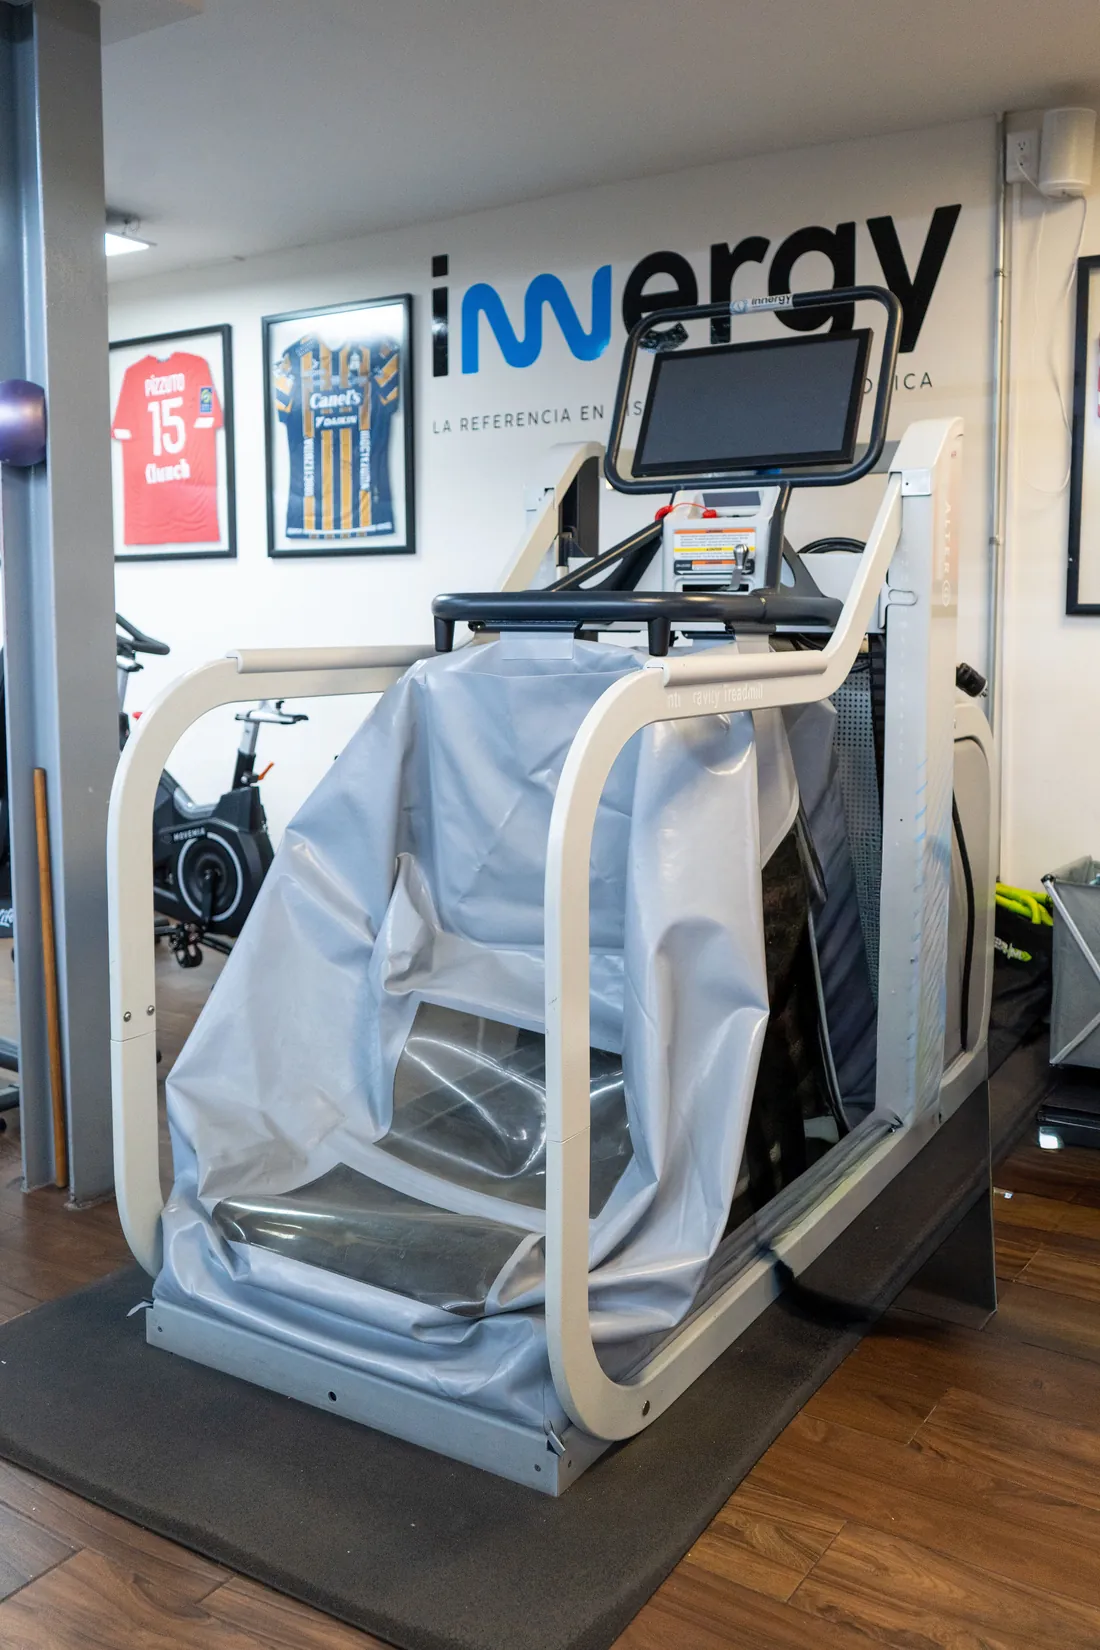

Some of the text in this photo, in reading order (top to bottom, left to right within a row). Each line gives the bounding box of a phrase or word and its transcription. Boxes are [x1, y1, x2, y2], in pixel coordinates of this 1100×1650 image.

[751, 295, 792, 305] innergy
[310, 389, 361, 409] Canel's
[147, 396, 186, 456] 15
[432, 419, 452, 434] LA
[460, 408, 571, 432] REFERENCIA
[580, 404, 604, 421] EN
